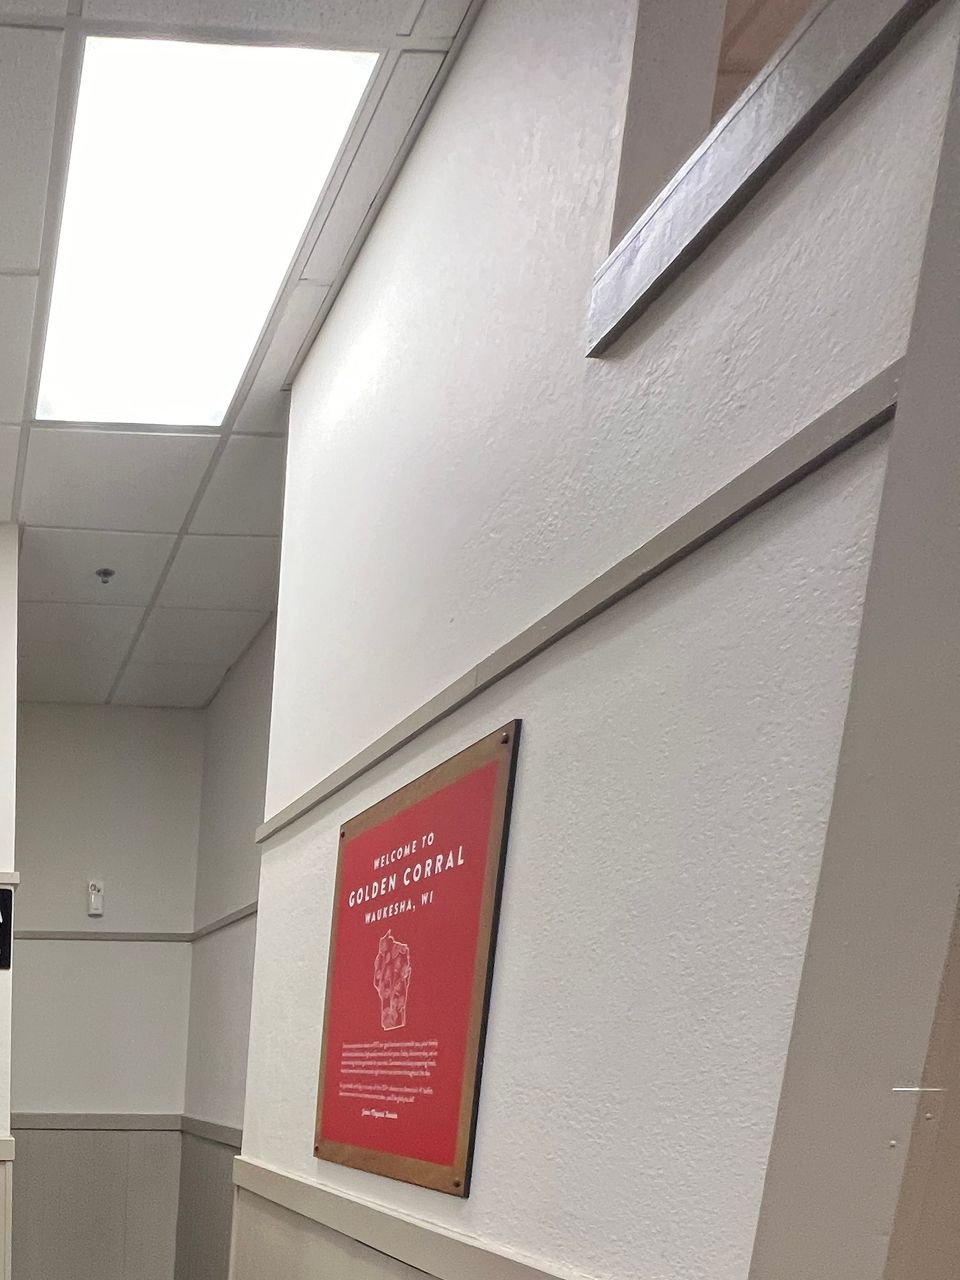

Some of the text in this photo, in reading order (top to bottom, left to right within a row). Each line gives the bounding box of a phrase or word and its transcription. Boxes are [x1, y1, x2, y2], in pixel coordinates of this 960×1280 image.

[373, 832, 434, 870] WELCOME TO
[349, 845, 464, 908] GOLDEN CORRAL
[364, 890, 433, 924] WAUKESHA, WI
